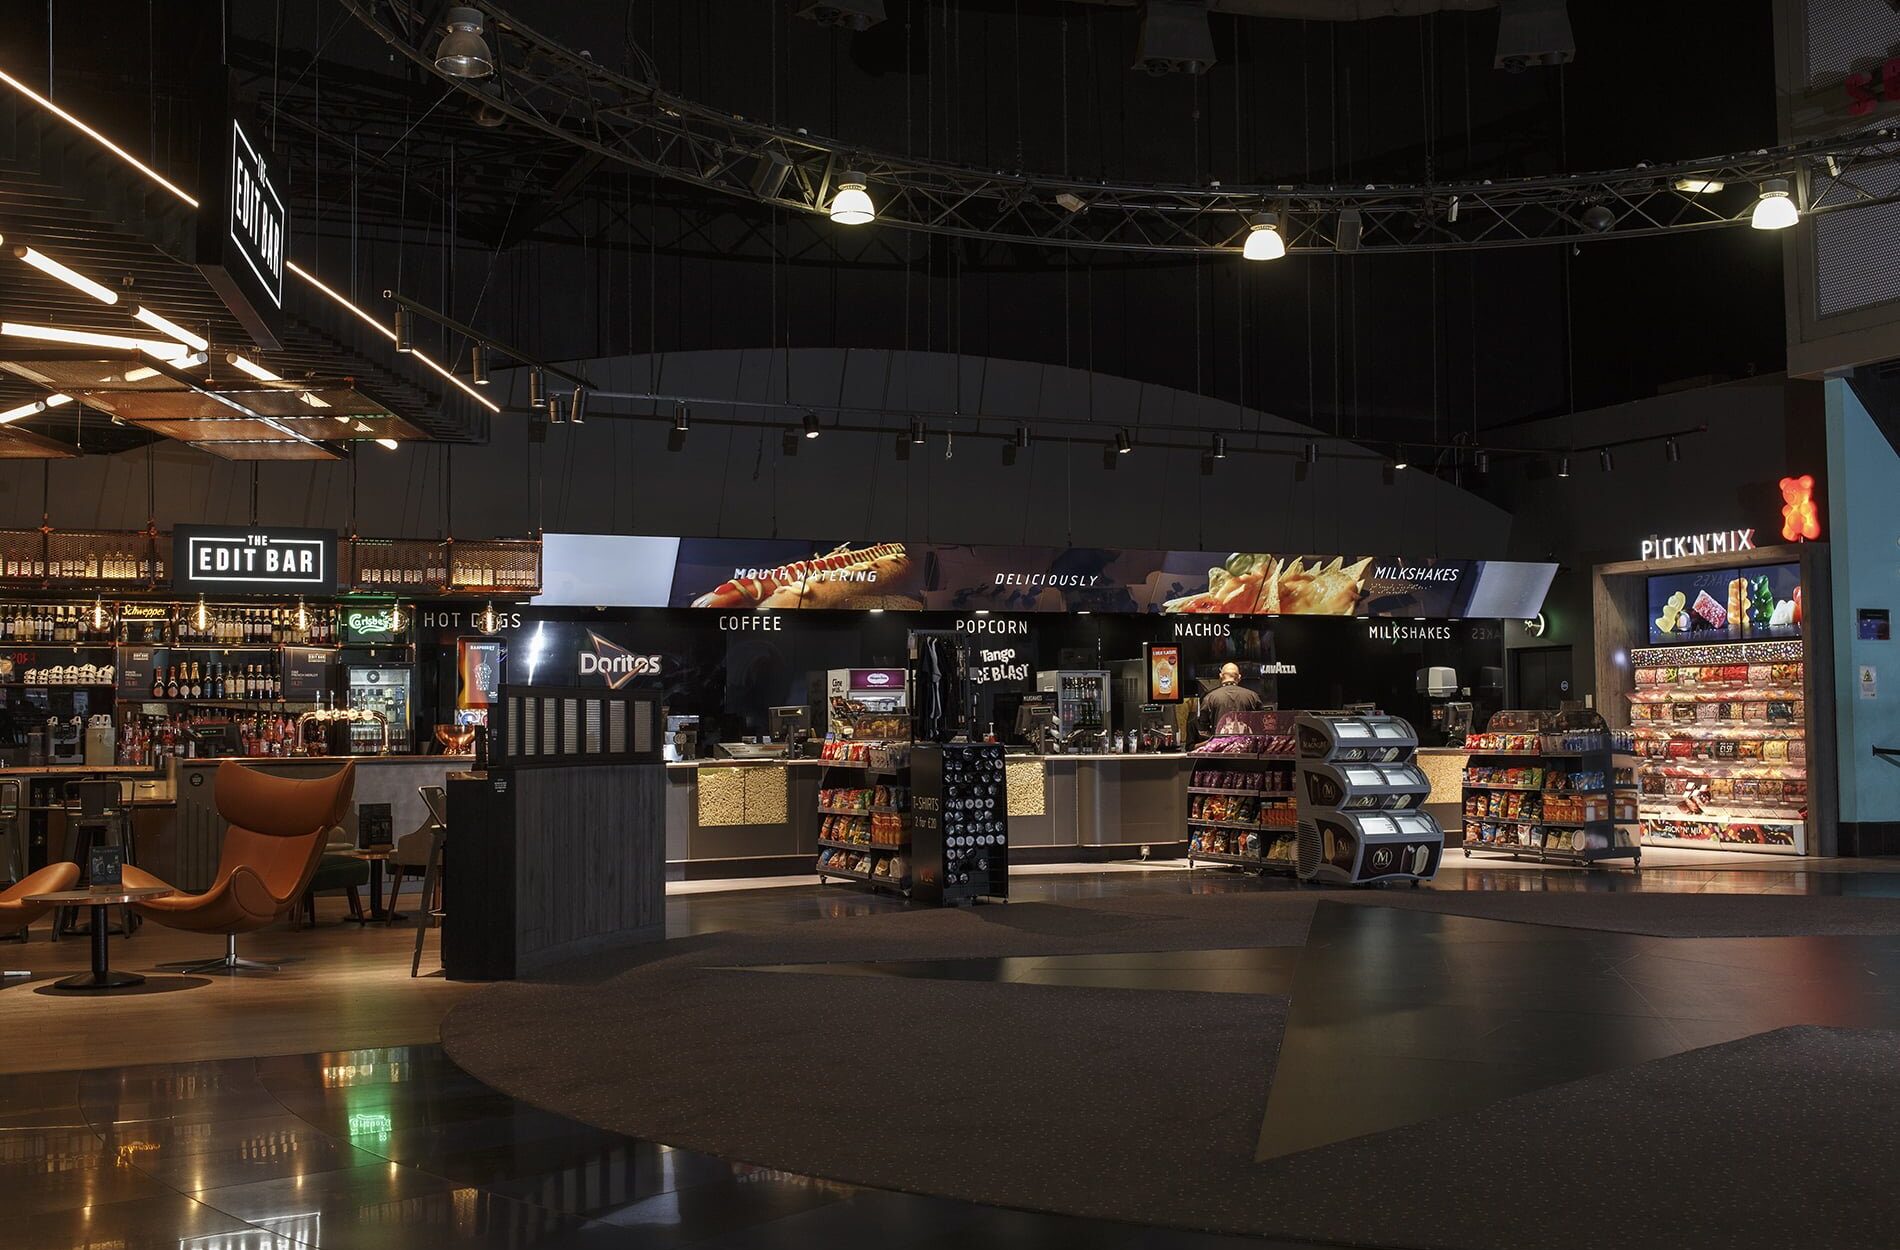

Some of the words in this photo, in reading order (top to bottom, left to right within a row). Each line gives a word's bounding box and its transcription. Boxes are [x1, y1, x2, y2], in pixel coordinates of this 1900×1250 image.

[257, 153, 267, 188] THE
[235, 156, 261, 246] EDIT
[261, 201, 280, 280] BAR
[247, 535, 268, 546] THE
[1642, 528, 1753, 561] PICK'N'MIX
[200, 547, 256, 571] EDIT
[266, 549, 313, 573] BAR
[734, 568, 788, 581] MOUTH
[797, 569, 878, 582] WATERING
[995, 573, 1098, 586] DELICIOUSLY
[1374, 566, 1459, 581] MILKSHAKES
[122, 604, 166, 617] Schweppes
[424, 612, 461, 628] HOT
[471, 613, 521, 628] DGS
[719, 616, 781, 630] COFFEE
[956, 619, 1027, 634] POPCORN
[1174, 623, 1231, 637] NACHOS
[1368, 625, 1451, 639] MILKSHAKES
[580, 652, 661, 674] Doritos
[981, 648, 1015, 664] Tango
[991, 663, 1029, 681] BLAST
[912, 795, 939, 812] T-SHIRTS
